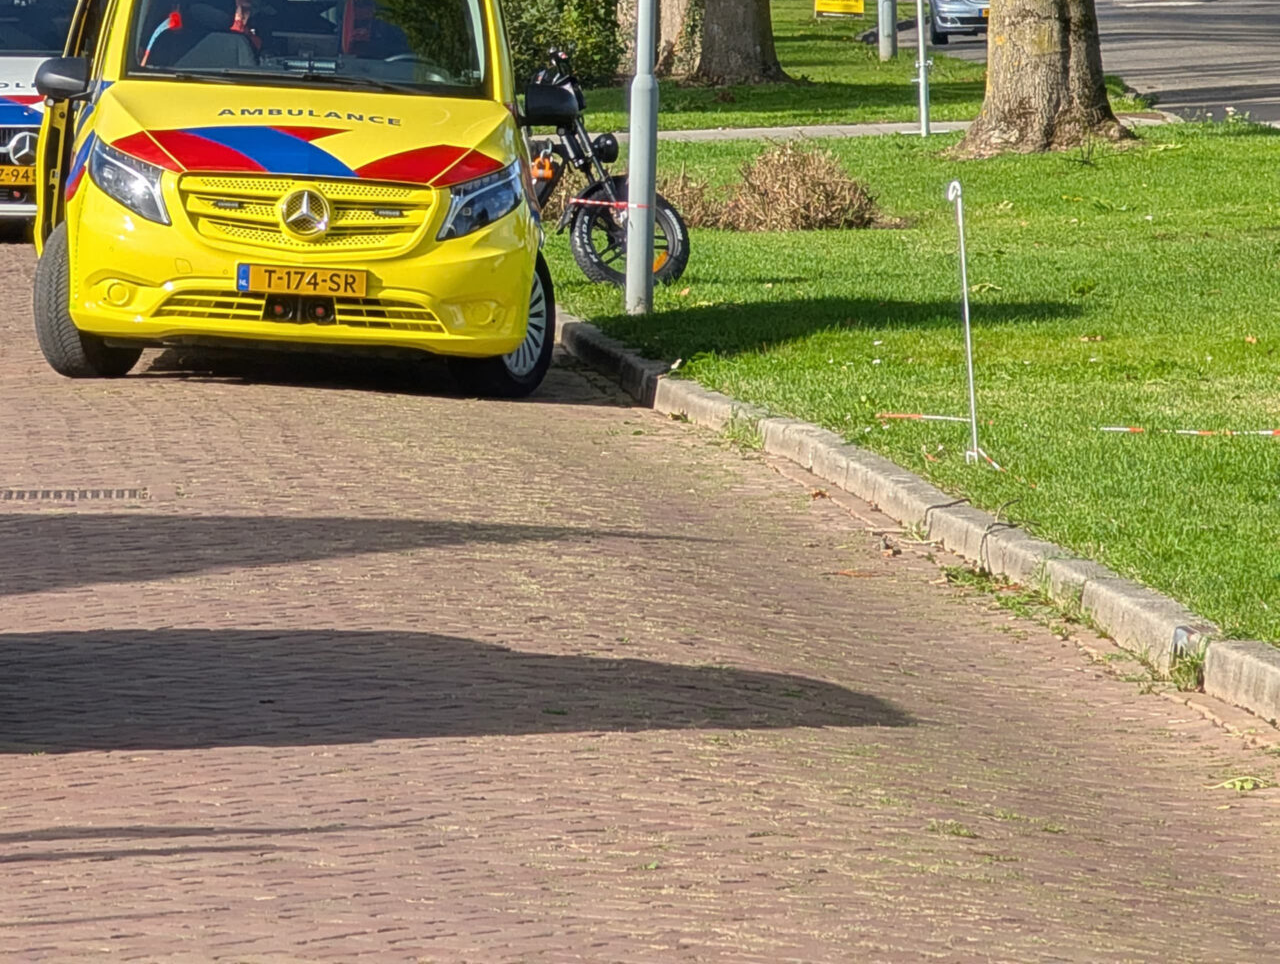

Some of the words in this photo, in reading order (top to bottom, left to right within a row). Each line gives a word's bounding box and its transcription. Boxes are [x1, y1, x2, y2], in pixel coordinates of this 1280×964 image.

[218, 109, 402, 127] AMBULANCE
[582, 215, 598, 263] KENDA
[264, 269, 357, 294] T-174-SR
